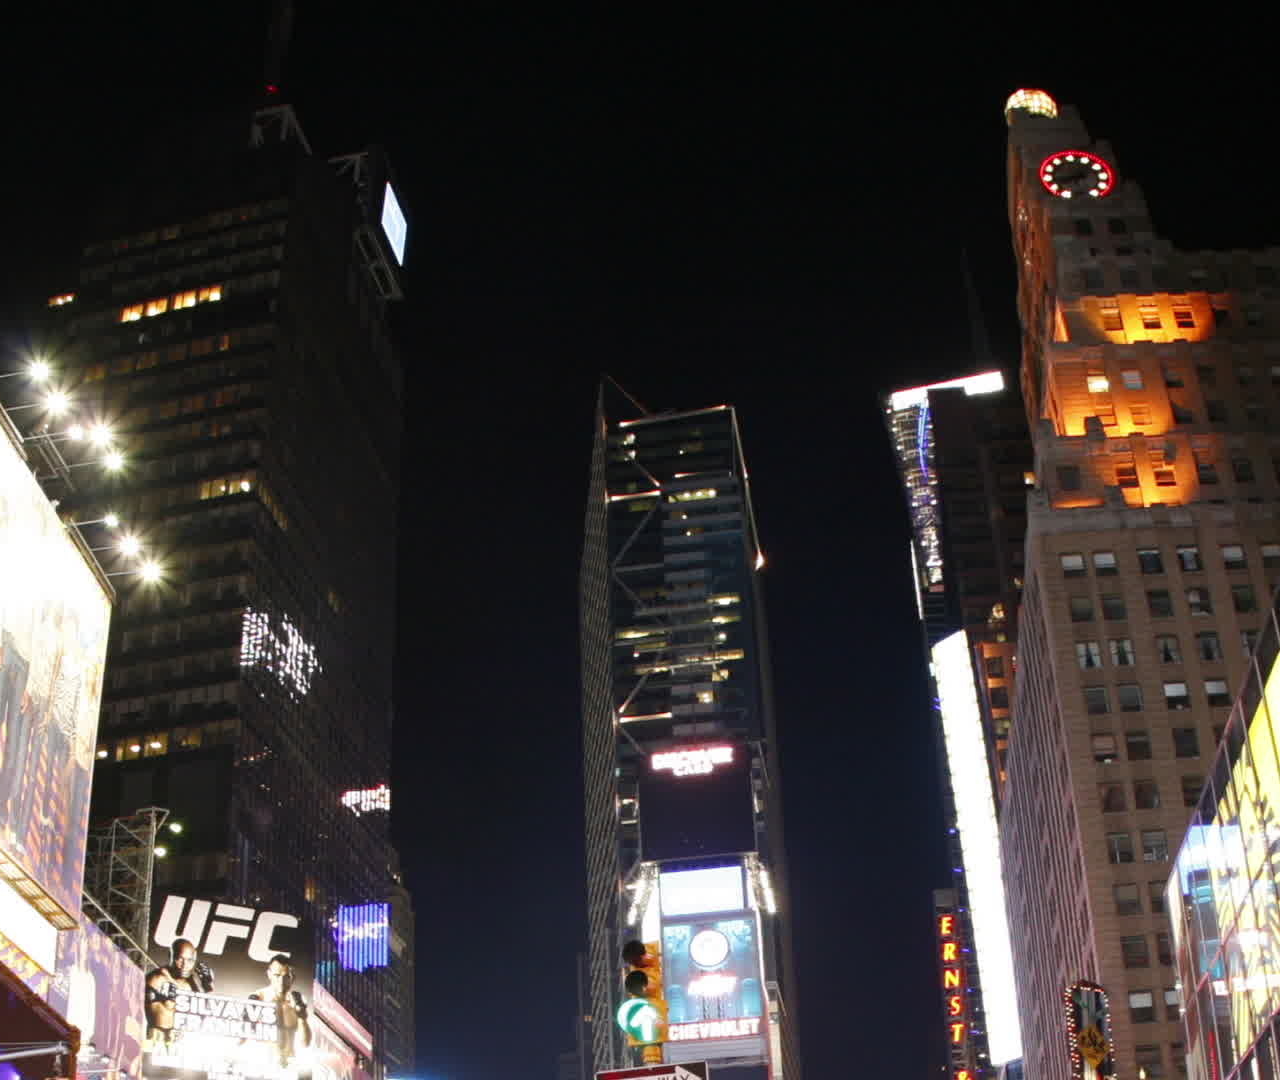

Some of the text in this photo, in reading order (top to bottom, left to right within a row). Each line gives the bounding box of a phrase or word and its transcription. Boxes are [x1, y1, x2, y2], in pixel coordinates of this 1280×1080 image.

[154, 895, 298, 963] UFC
[941, 914, 965, 1043] ERNST
[175, 993, 278, 1024] SILVA VS
[174, 1012, 278, 1041] FRANKLIN
[670, 1019, 760, 1041] CHEVROLET
